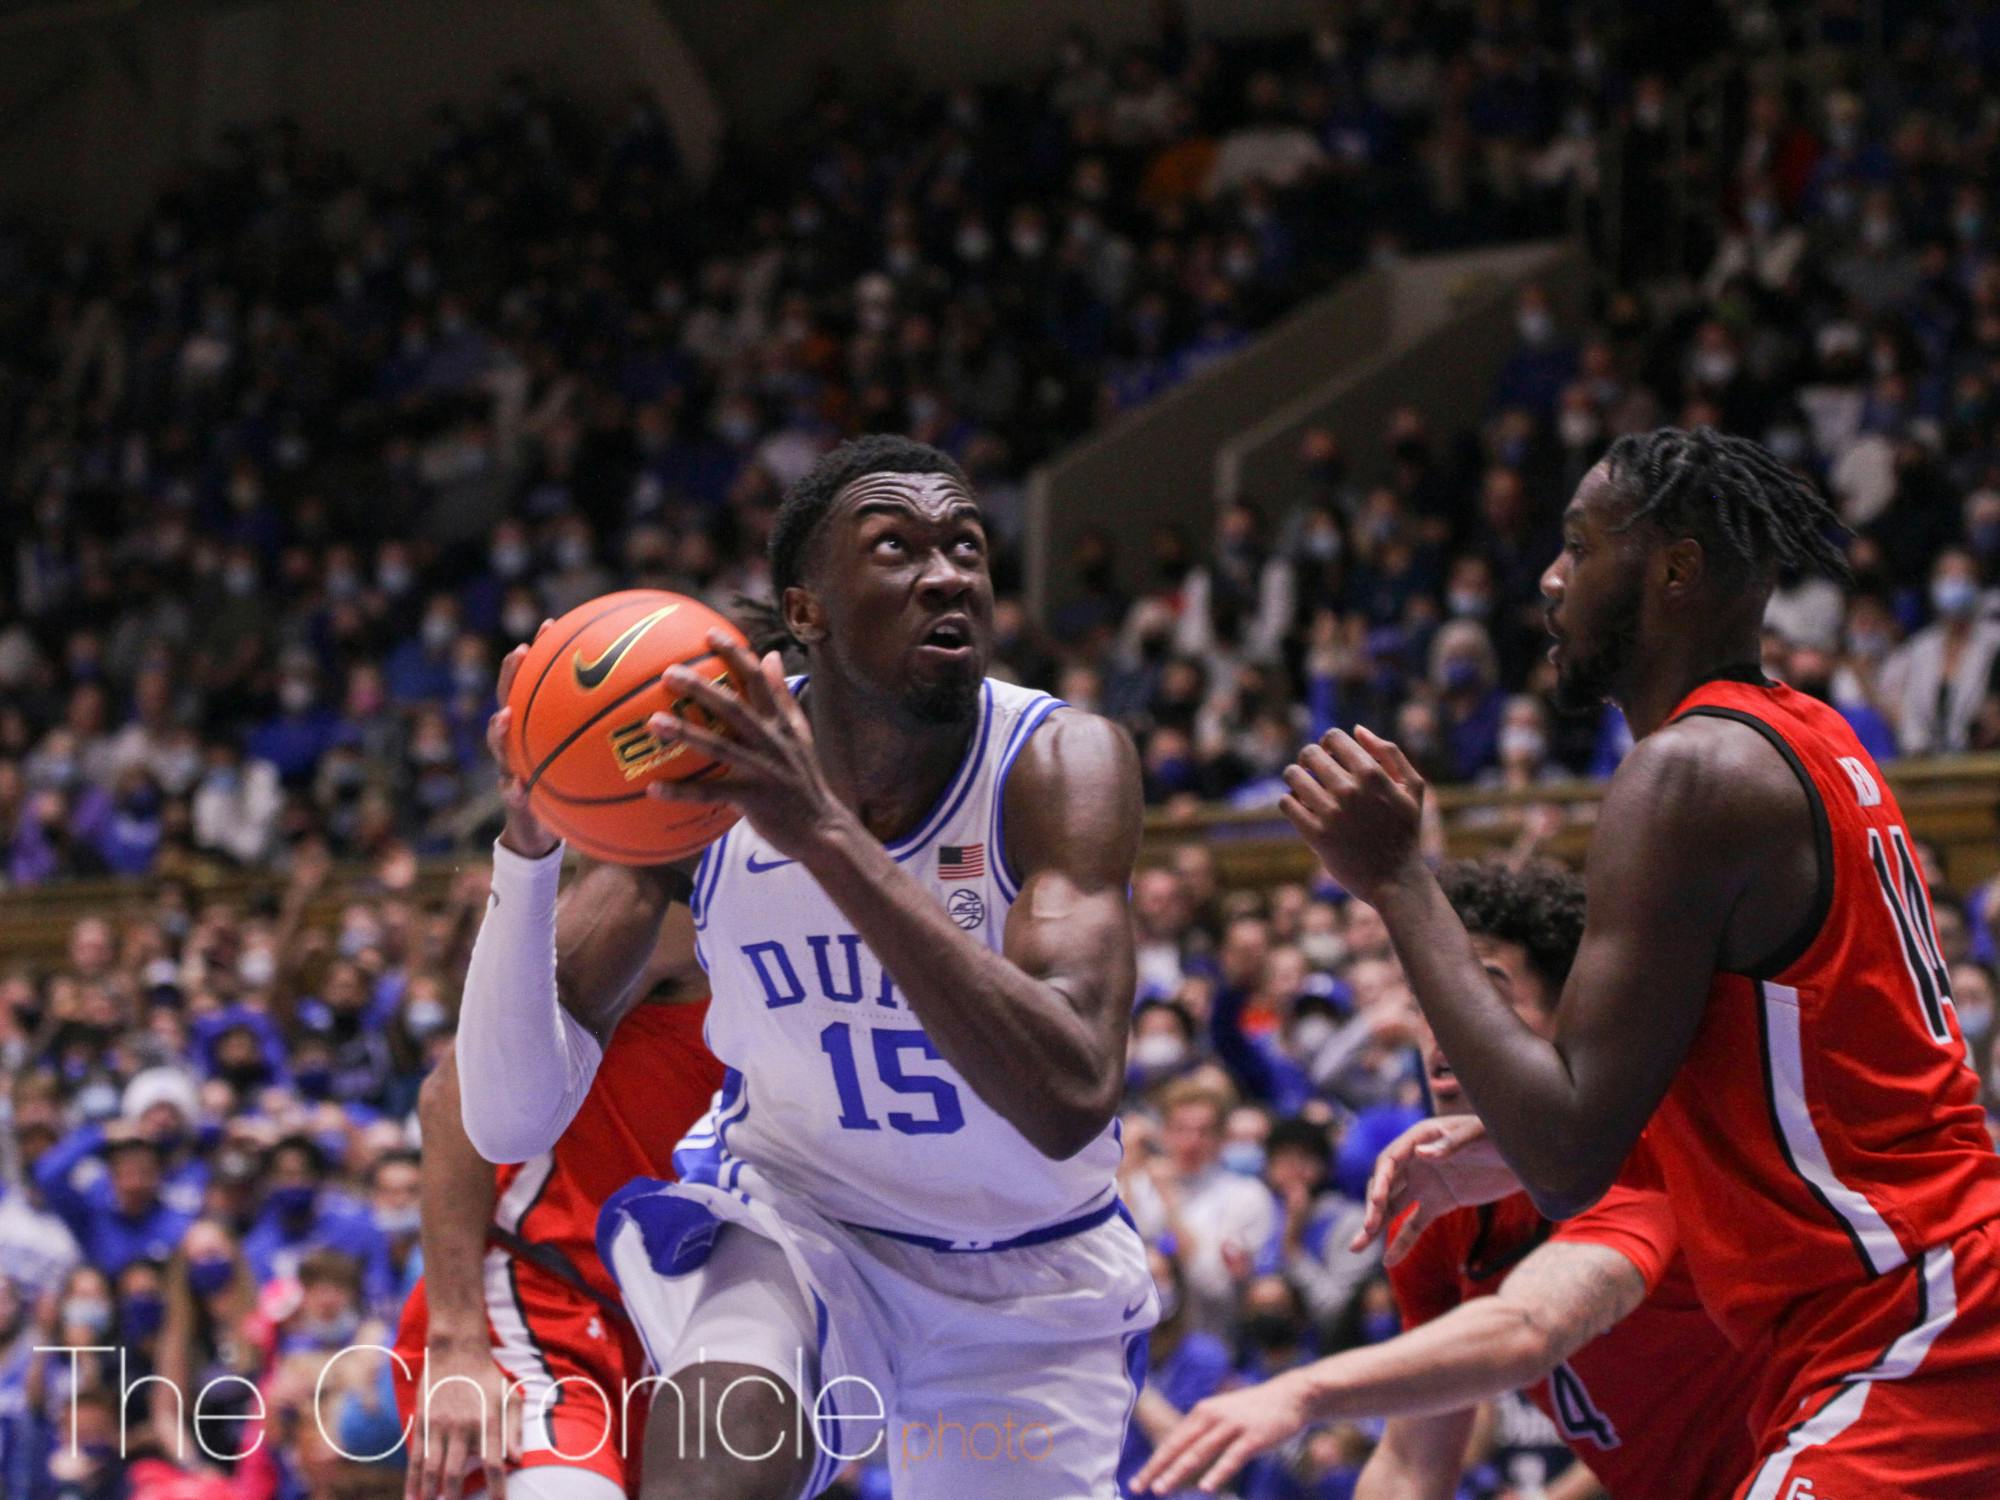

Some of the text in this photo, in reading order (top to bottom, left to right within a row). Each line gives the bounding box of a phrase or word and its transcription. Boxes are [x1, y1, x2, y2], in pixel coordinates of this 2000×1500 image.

[741, 933, 912, 1010] DU
[1867, 825, 1952, 1045] 14
[820, 1021, 966, 1135] 15
[1549, 1360, 1622, 1449] 4
